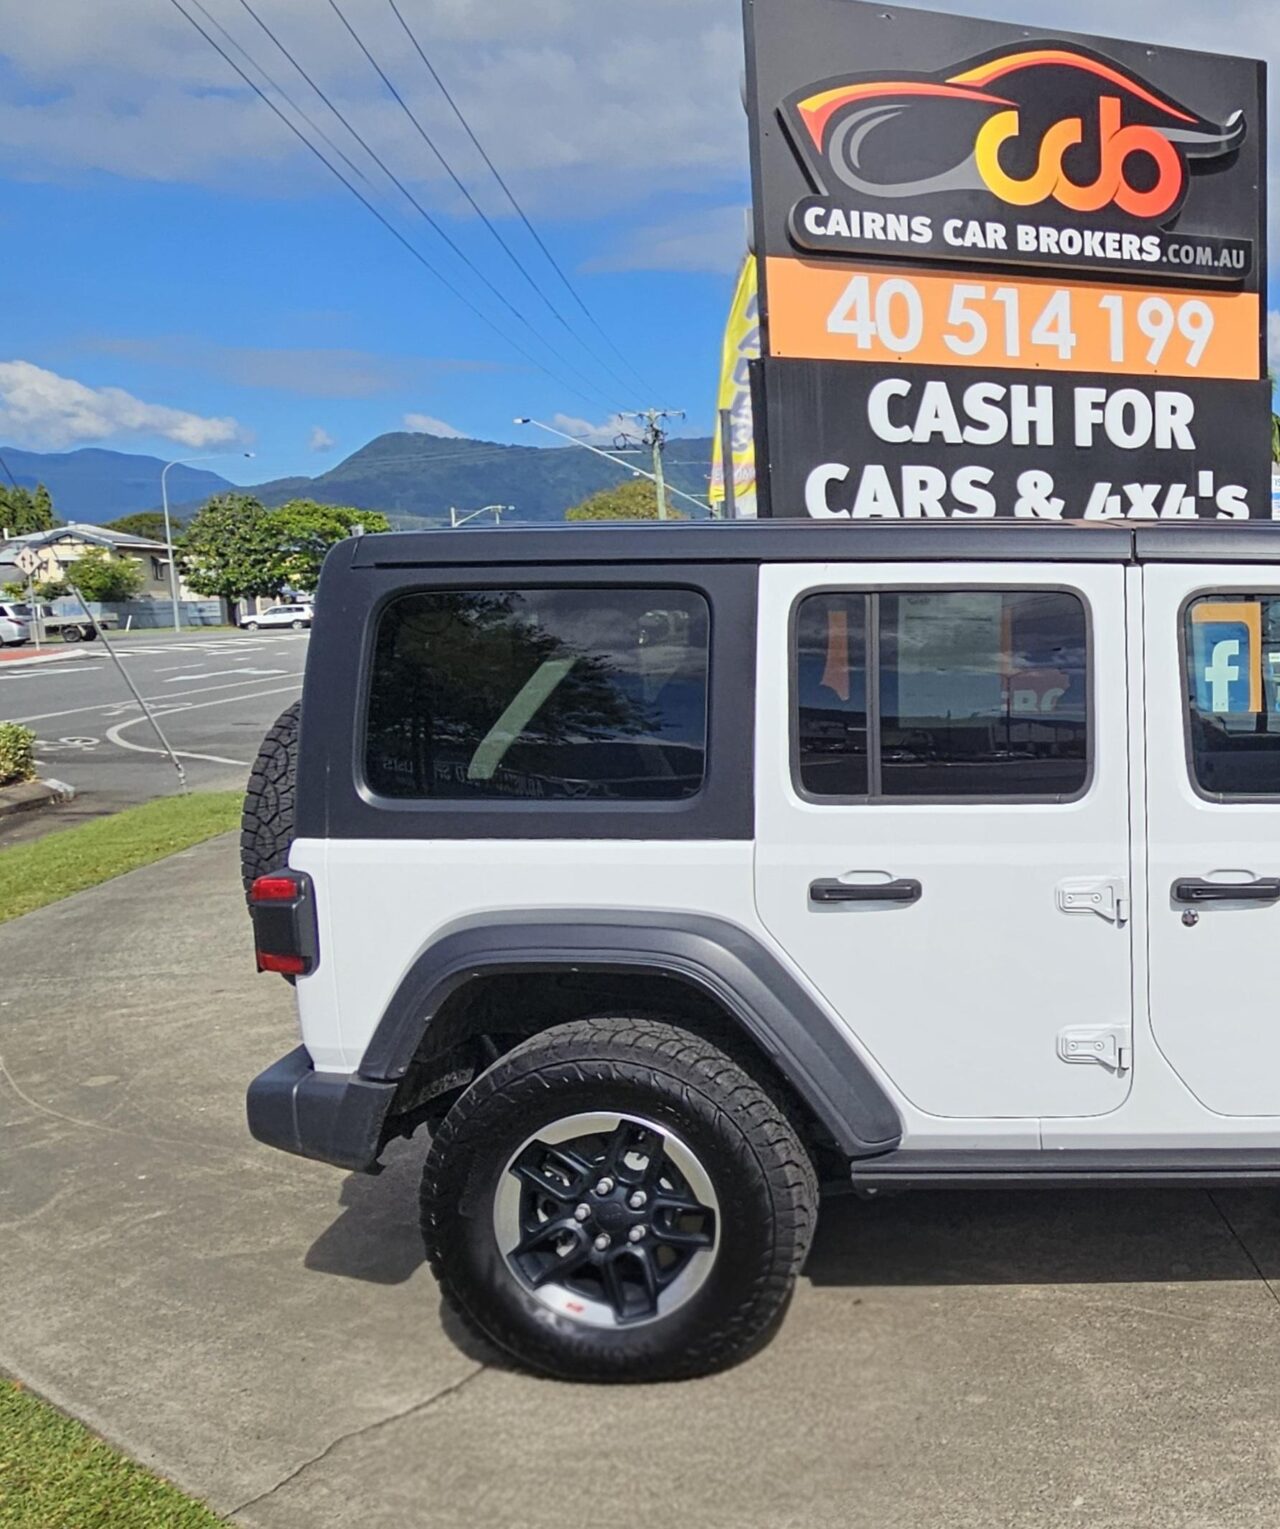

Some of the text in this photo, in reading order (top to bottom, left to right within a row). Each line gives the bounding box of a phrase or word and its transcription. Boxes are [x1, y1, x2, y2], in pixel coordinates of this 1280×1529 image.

[804, 206, 933, 244] CAIRNS
[943, 219, 1008, 250] CAR
[826, 275, 1215, 368] 40 514 199
[868, 378, 1196, 450] CASH FOR
[805, 462, 997, 518] CARS
[1014, 470, 1064, 519] &
